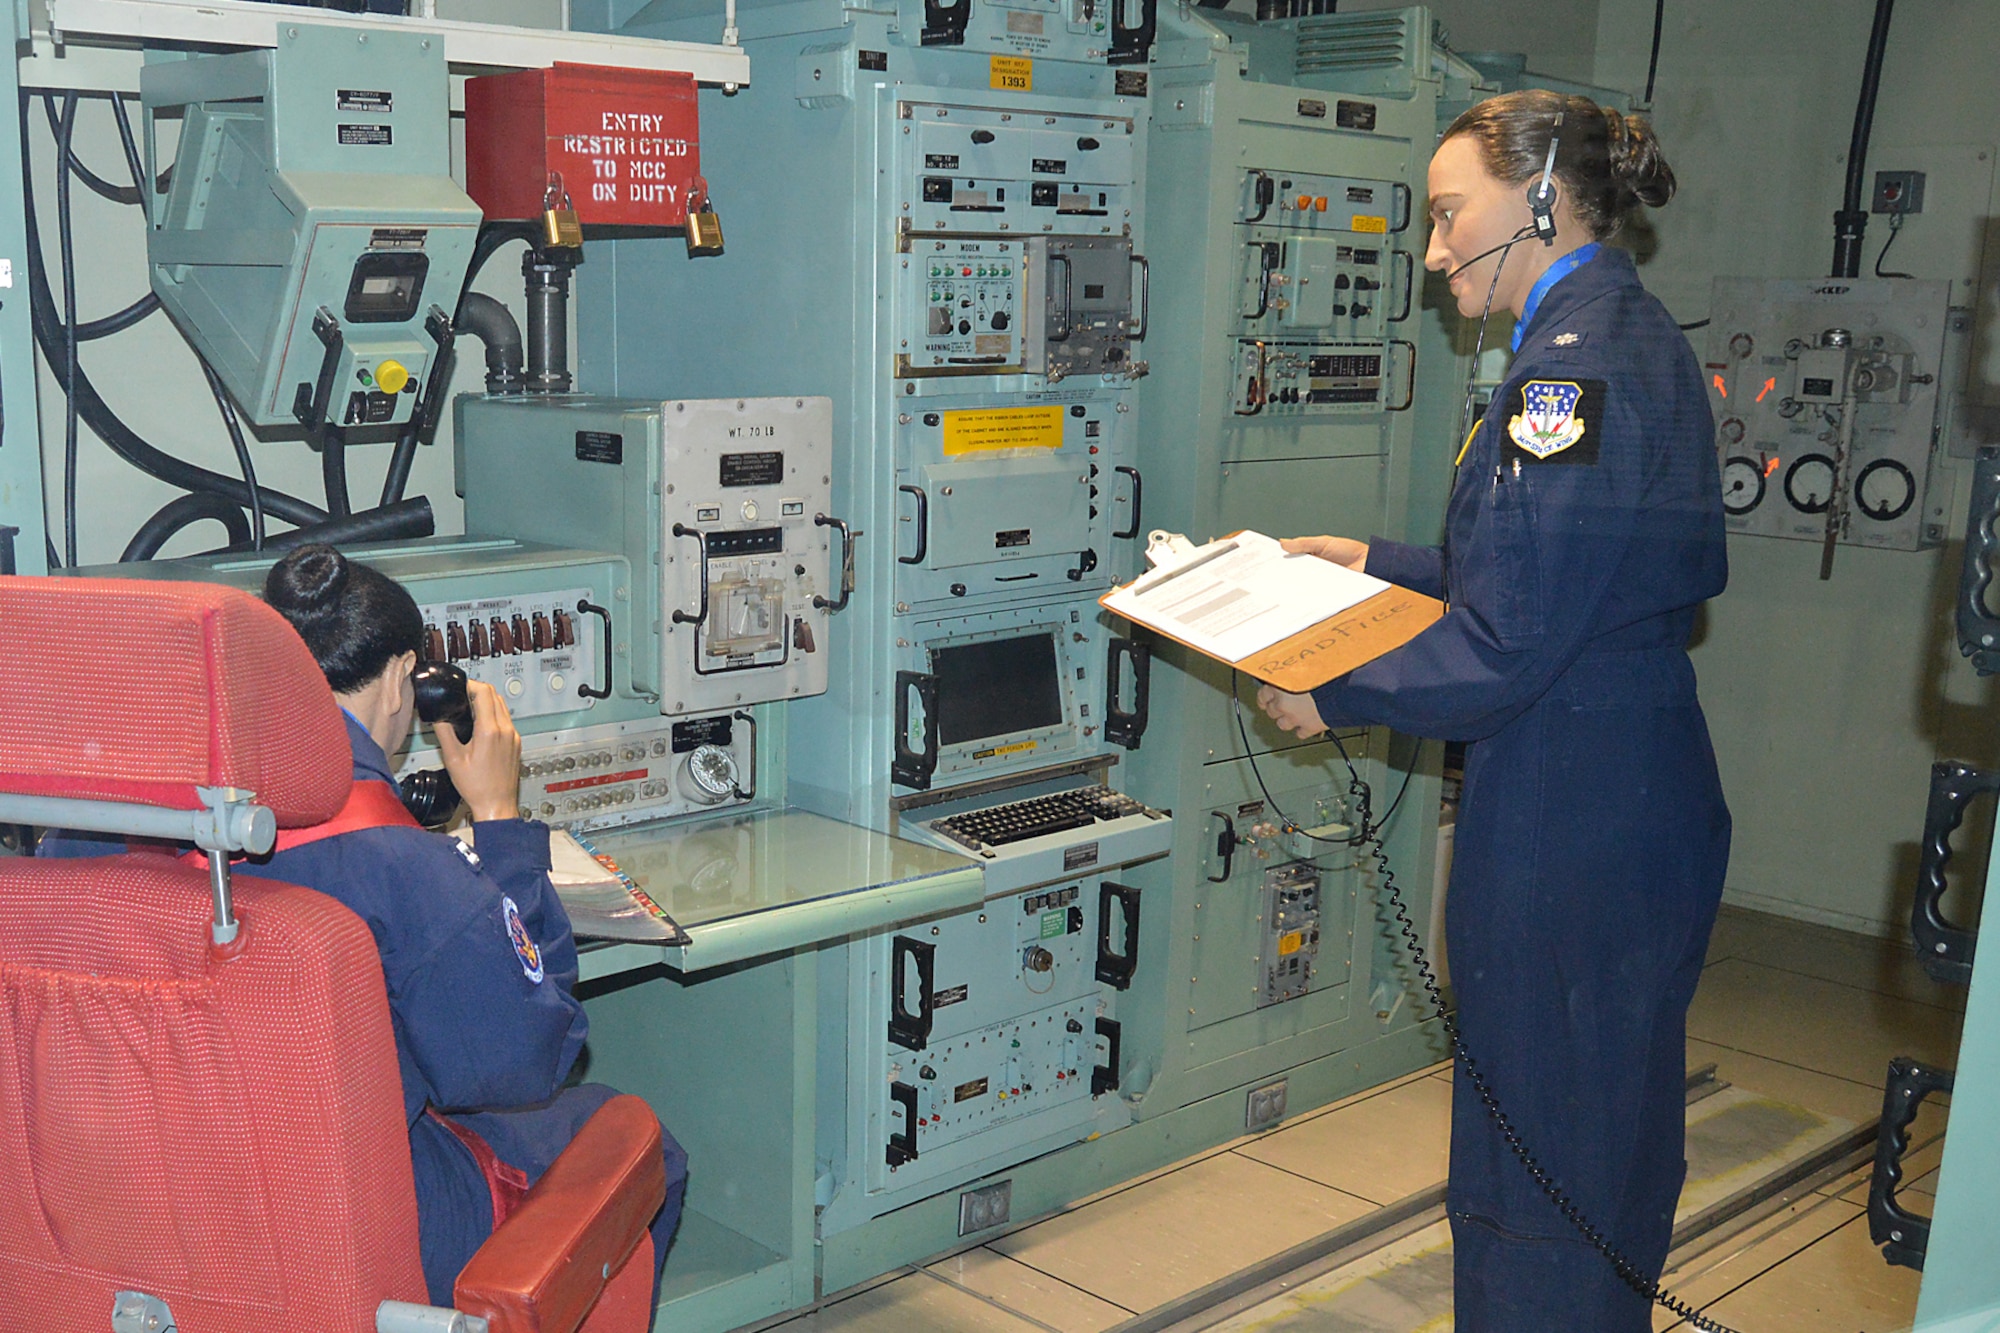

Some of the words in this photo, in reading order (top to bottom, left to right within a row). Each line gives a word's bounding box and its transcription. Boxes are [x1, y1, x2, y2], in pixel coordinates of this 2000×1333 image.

[866, 51, 880, 60] UNIT
[1002, 76, 1026, 88] 1393
[602, 112, 664, 133] ENTRY
[564, 134, 688, 157] RESTRICTED
[592, 159, 617, 178] TO
[630, 160, 667, 180] MCC
[592, 183, 617, 202] ON
[630, 184, 678, 204] DUTY
[960, 243, 980, 252] MODEM
[926, 344, 950, 352] WARNING
[750, 427, 760, 437] 70
[765, 426, 774, 436] LB
[1530, 442, 1553, 454] SPACE
[1554, 435, 1573, 448] WING
[1258, 638, 1336, 674] READ
